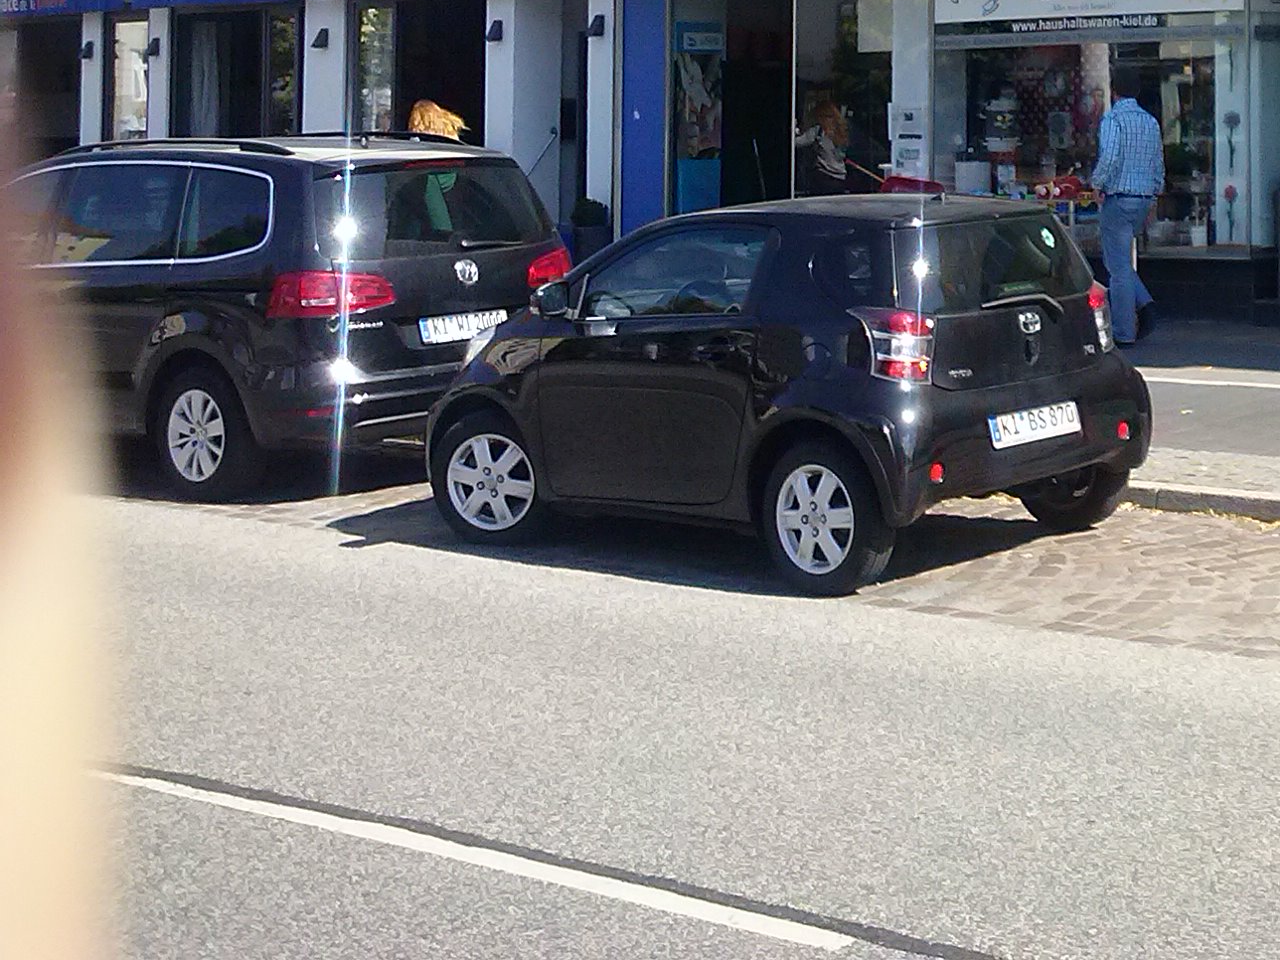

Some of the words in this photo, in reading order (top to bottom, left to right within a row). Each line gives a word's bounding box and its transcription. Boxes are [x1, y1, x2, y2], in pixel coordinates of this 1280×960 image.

[1012, 15, 1158, 32] www.haushaltswaren-kiel.de
[1001, 413, 1020, 436] KI
[1028, 409, 1047, 431] BS
[1049, 404, 1075, 426] 870
